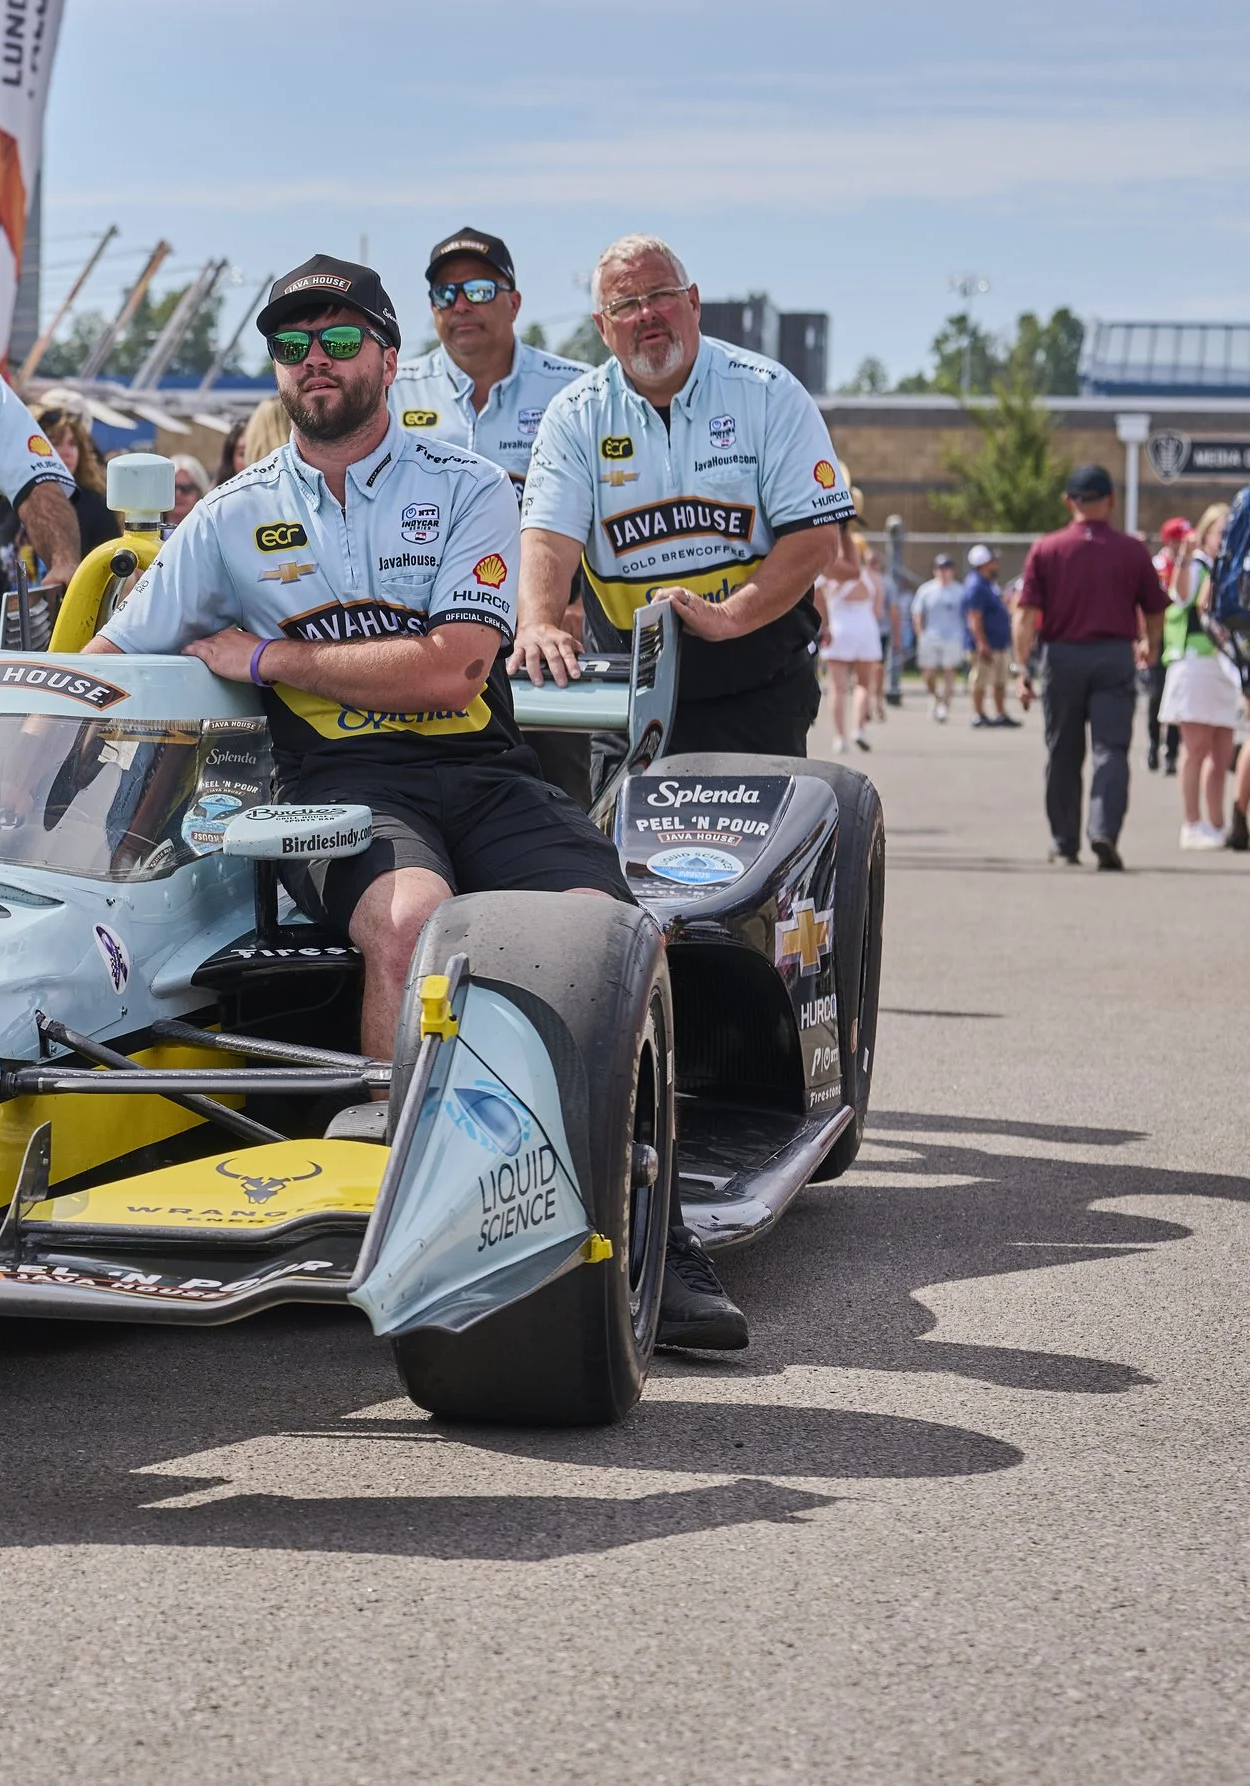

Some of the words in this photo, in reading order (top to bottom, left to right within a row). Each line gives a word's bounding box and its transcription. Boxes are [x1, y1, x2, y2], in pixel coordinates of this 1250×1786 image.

[312, 276, 346, 288] HOUSE
[405, 412, 434, 425] ecr
[415, 443, 480, 465] Firestone
[811, 490, 849, 509] HURCO
[418, 509, 436, 517] NTT
[401, 519, 440, 529] INDYCAR
[612, 510, 668, 547] JAVA
[672, 505, 742, 534] HOUSE
[261, 526, 300, 547] ecr
[378, 553, 440, 571] JavaHouse.
[622, 556, 656, 575] COLD
[452, 590, 510, 614] HURCO
[445, 612, 482, 622] OFFICIAL
[484, 615, 501, 629] CREW
[2, 667, 111, 702] HOUSE
[211, 721, 229, 729] JAVA
[231, 721, 256, 730] HOUSE
[205, 748, 257, 765] Splenda
[234, 782, 259, 794] POUR
[647, 780, 760, 808] Splenda
[635, 816, 685, 832] PEEL
[691, 815, 710, 830] 'N
[716, 817, 770, 837] POUR
[665, 833, 692, 842] JAVA
[696, 833, 736, 843] HOUSE
[801, 993, 838, 1030] HURCO
[809, 1083, 842, 1109] Firestone
[478, 1143, 558, 1215] LIQUID
[477, 1187, 557, 1253] SCIENCE
[16, 1273, 96, 1286] JAVA
[110, 1281, 227, 1299] HOUSE
